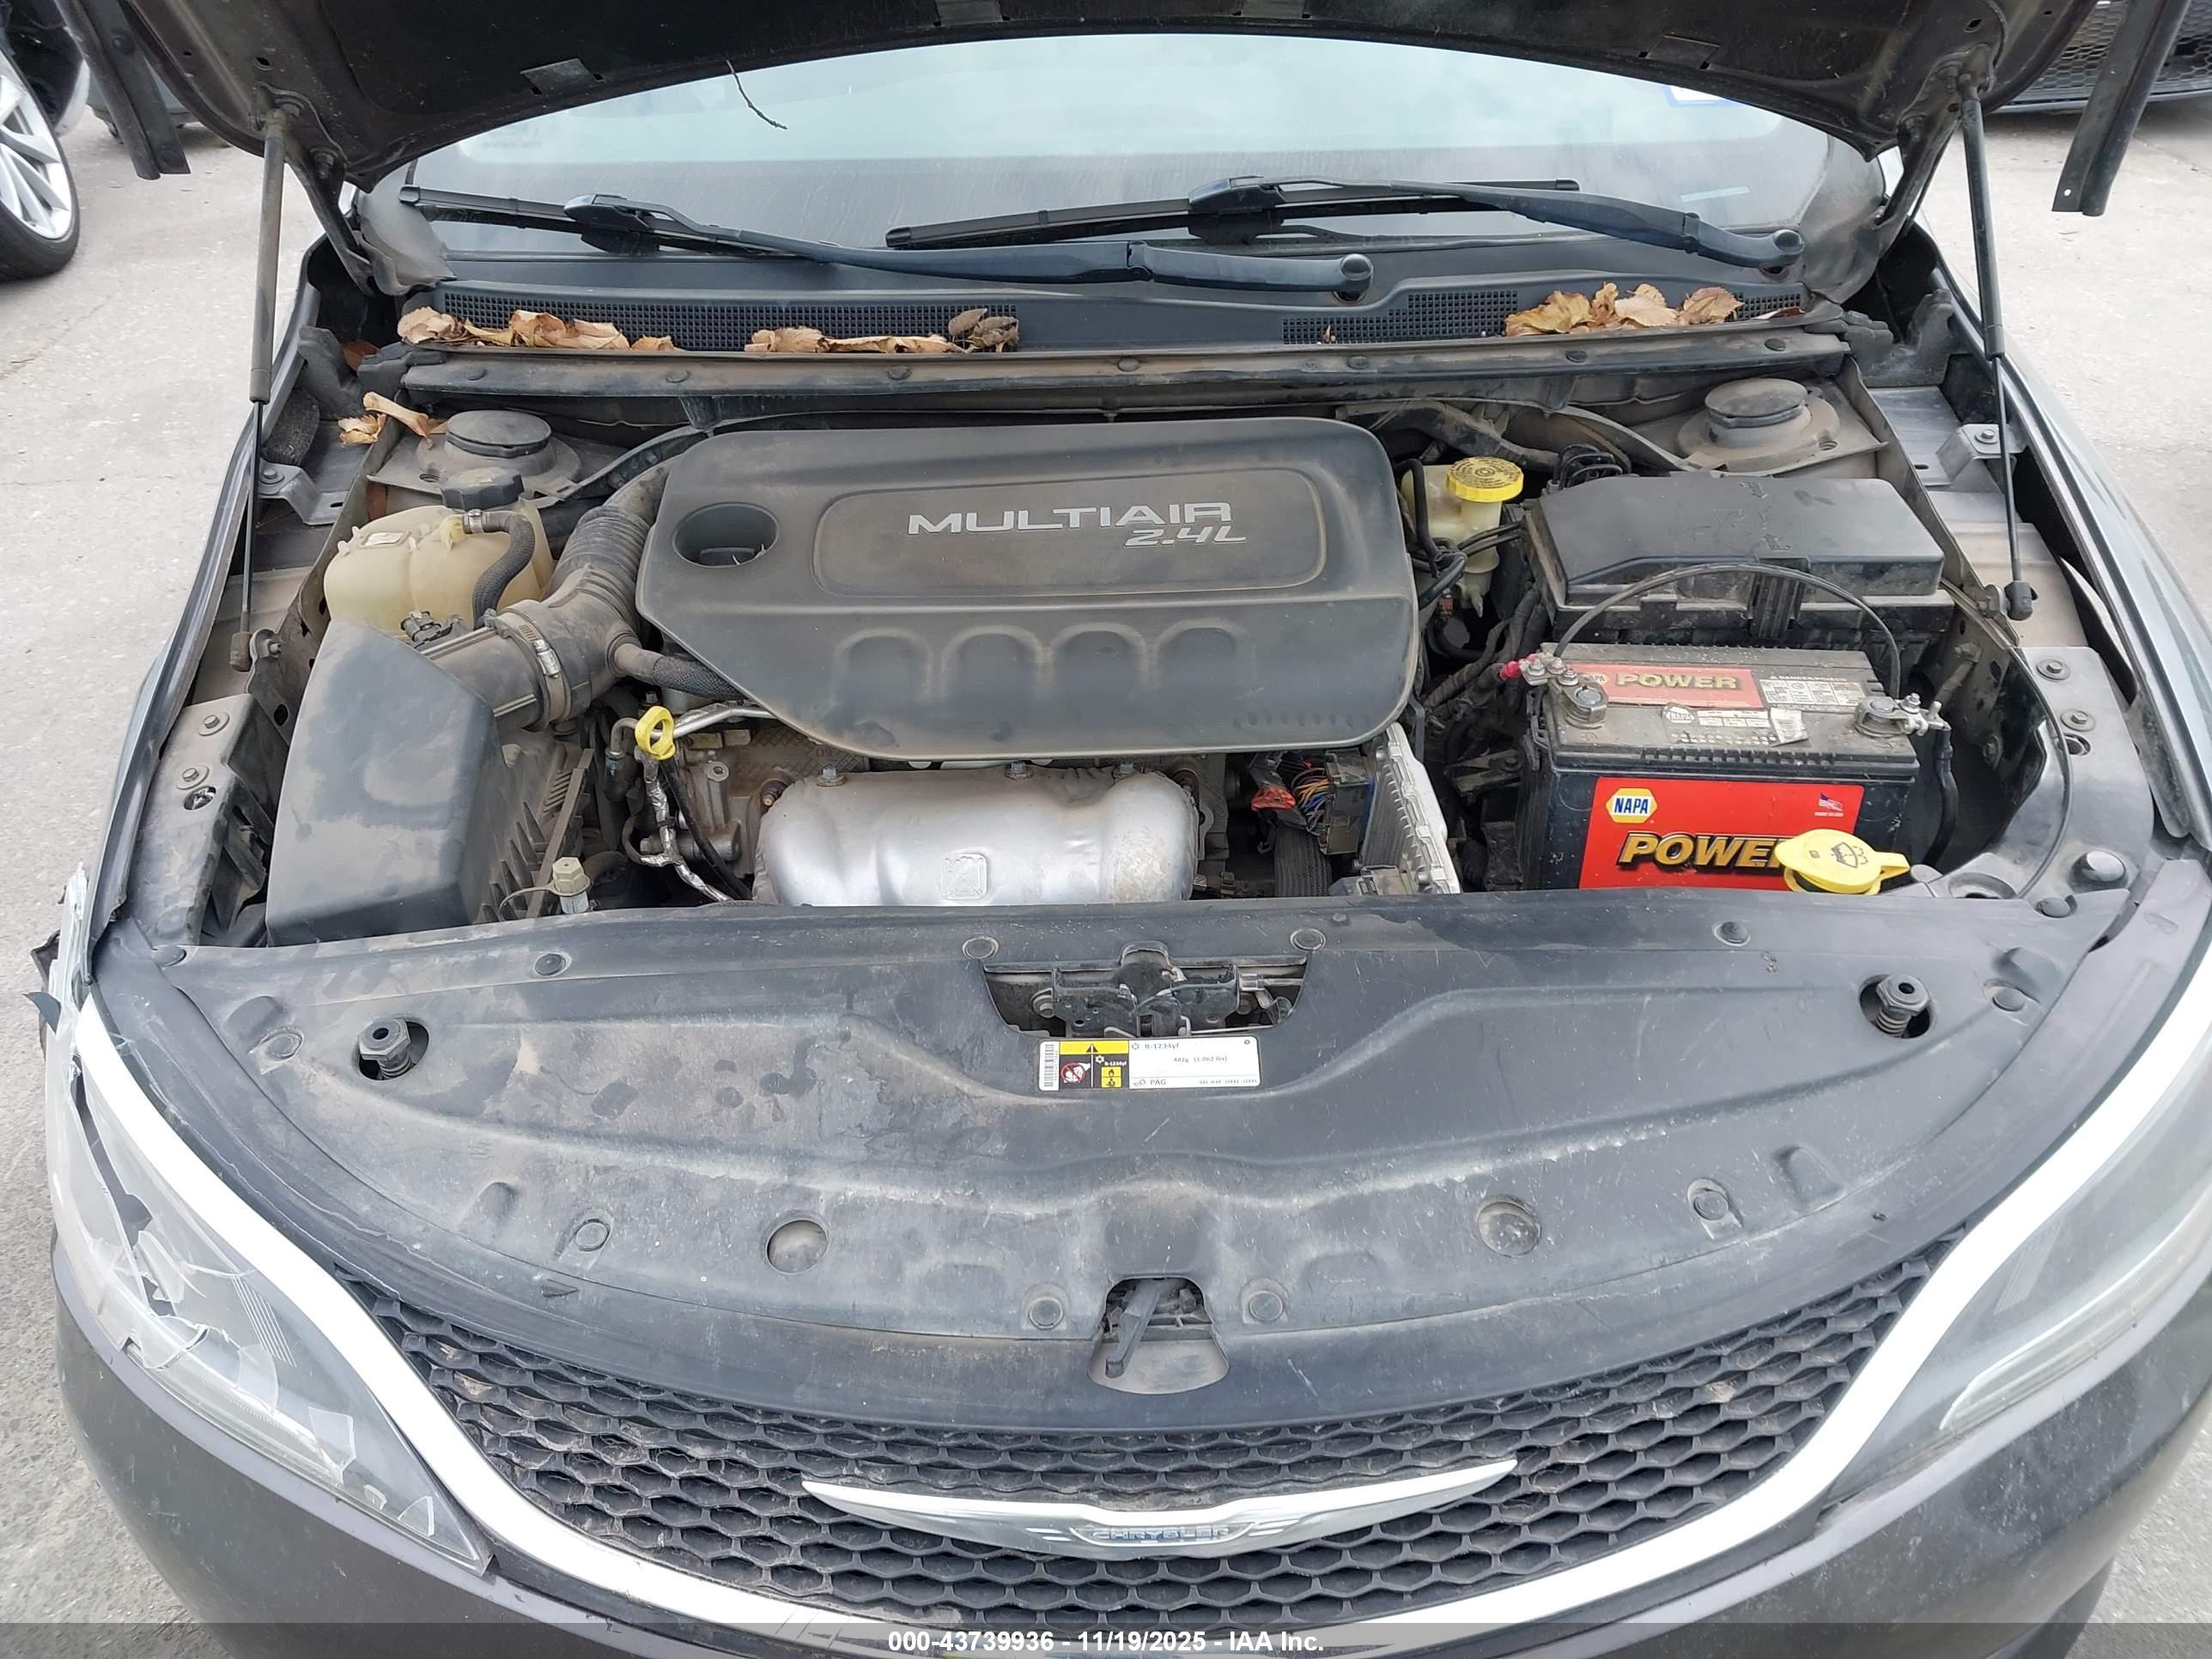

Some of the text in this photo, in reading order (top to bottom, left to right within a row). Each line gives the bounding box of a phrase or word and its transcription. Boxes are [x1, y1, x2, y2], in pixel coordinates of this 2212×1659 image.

[907, 501, 1233, 535] MULTIAIR
[1123, 525, 1247, 549] 2.4L
[1616, 672, 1740, 690] POWER
[1613, 797, 1649, 815] NAPA
[1092, 1526, 1230, 1540] CHRYSLER
